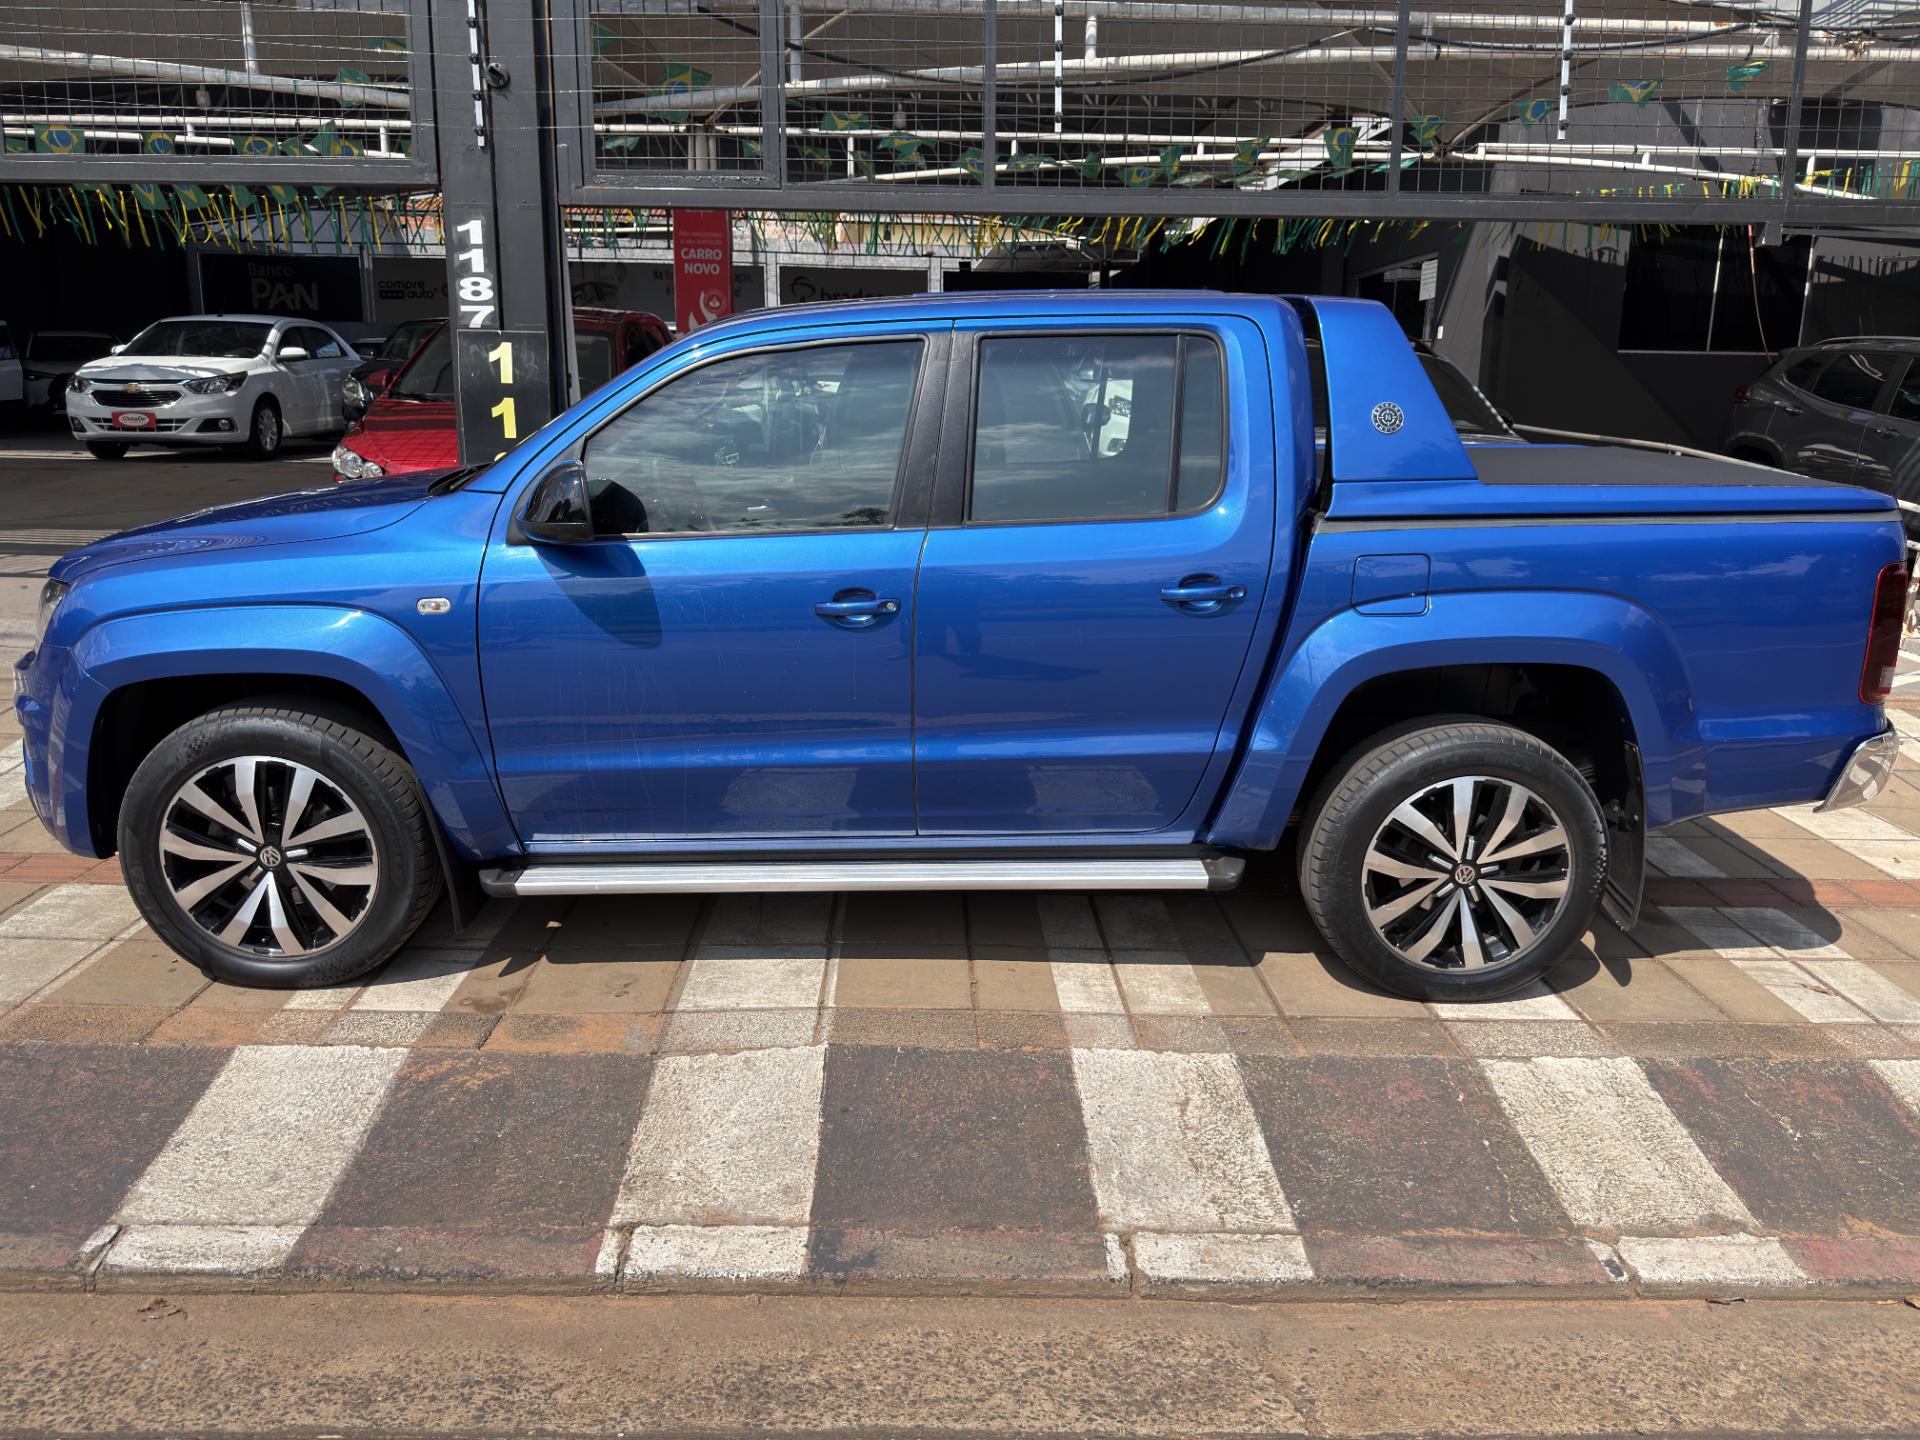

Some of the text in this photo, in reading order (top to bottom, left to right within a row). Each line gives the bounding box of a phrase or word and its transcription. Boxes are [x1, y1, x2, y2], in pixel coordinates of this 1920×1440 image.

[681, 248, 723, 261] CARRO
[248, 262, 294, 277] Banco
[456, 219, 495, 329] 1187
[684, 262, 721, 276] NOVO
[378, 280, 425, 291] compre
[251, 277, 319, 311] PAN
[407, 287, 434, 299] auto
[488, 342, 517, 461] 11
